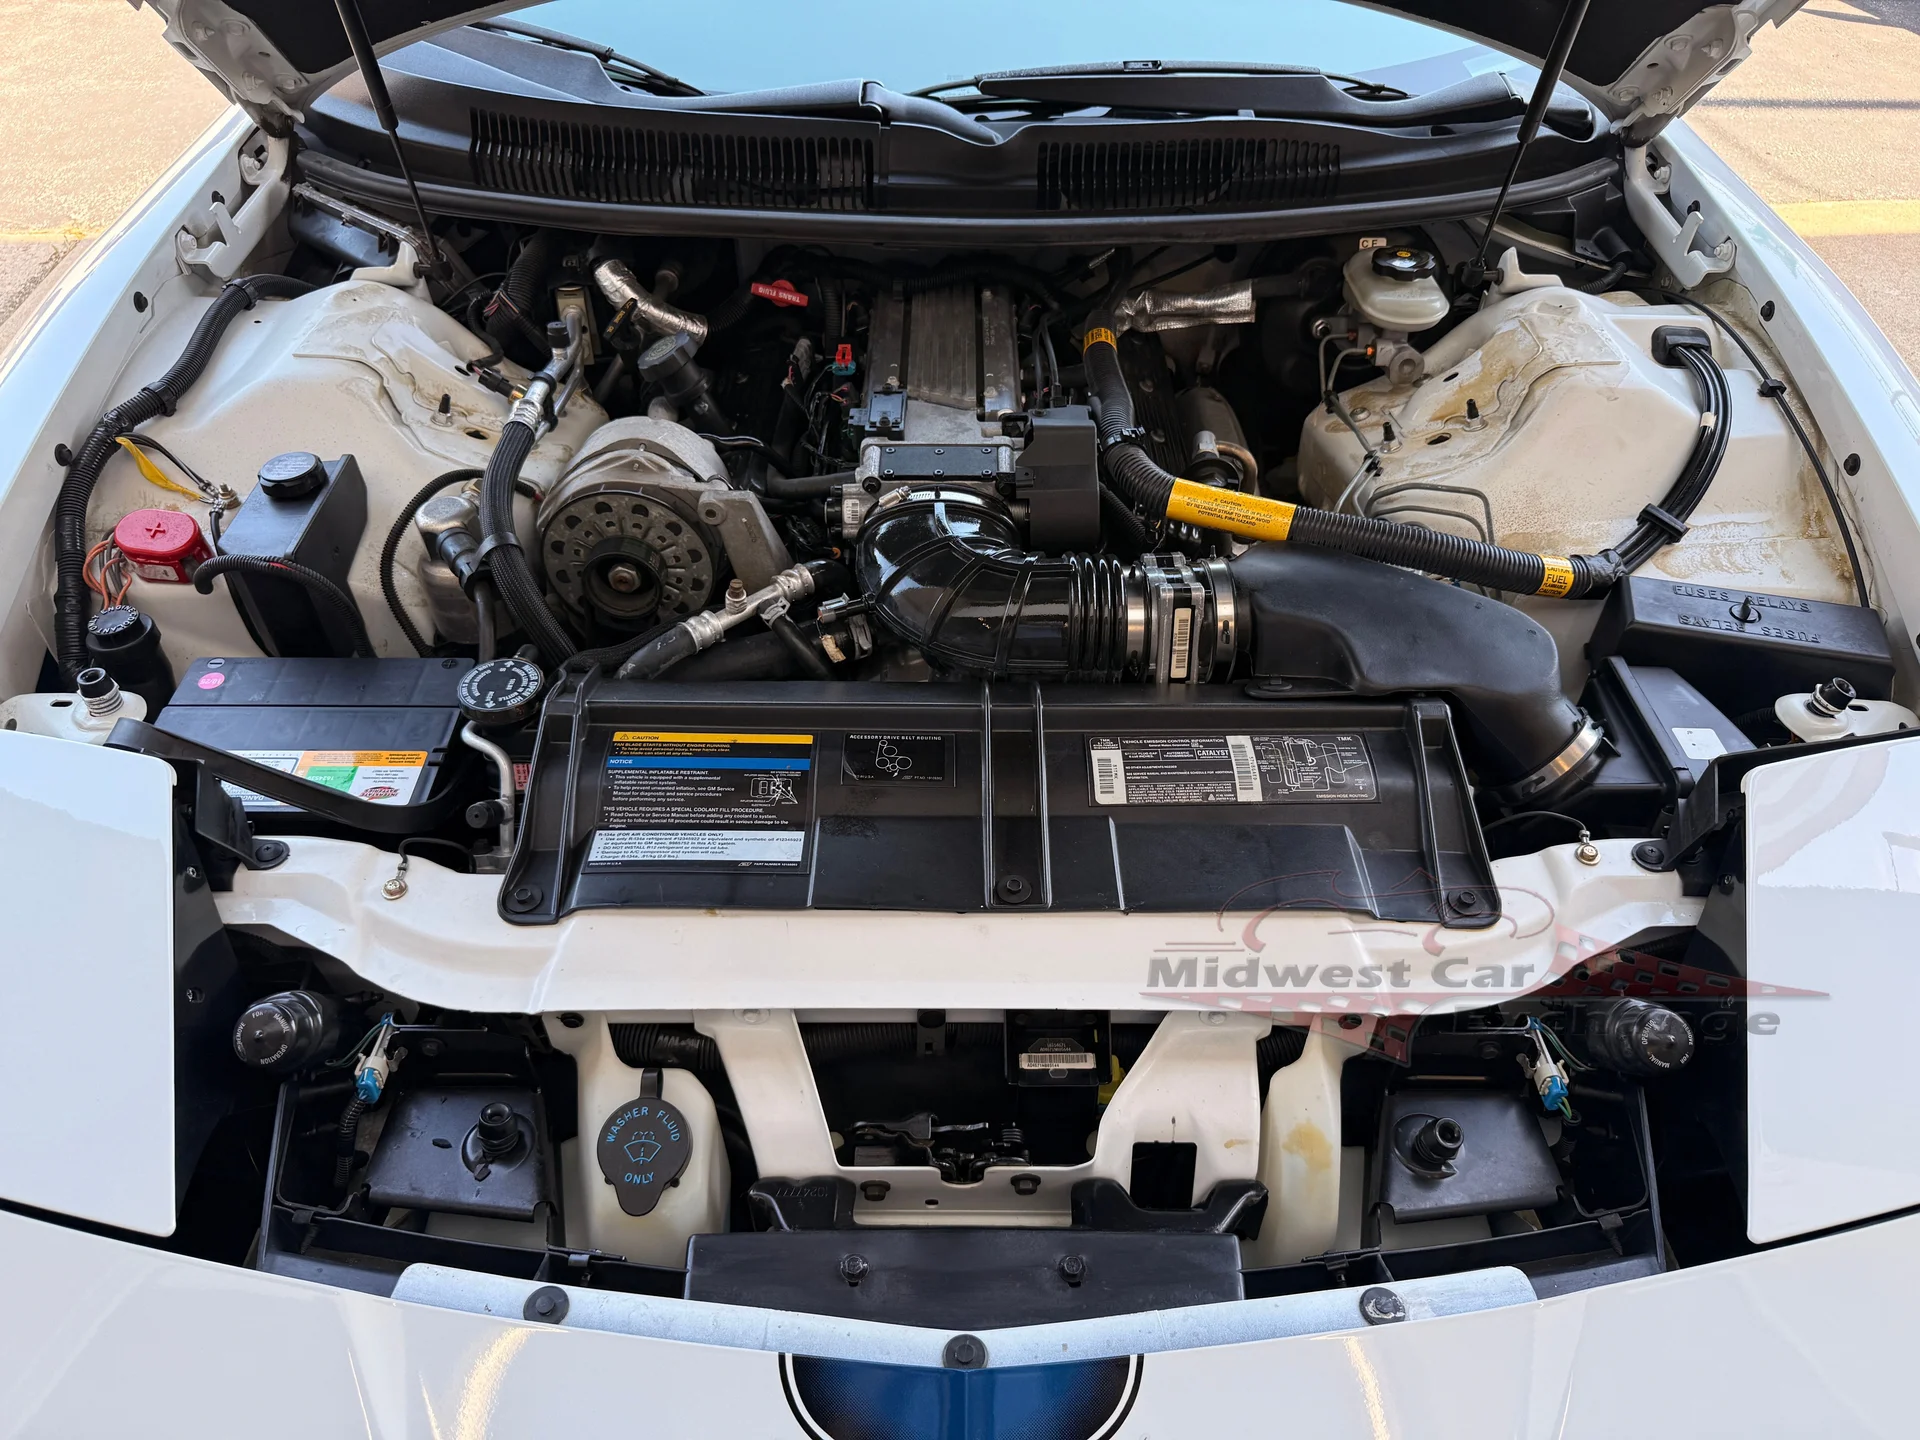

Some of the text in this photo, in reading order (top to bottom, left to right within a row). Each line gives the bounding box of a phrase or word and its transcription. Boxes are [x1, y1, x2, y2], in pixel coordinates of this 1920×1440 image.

[758, 287, 800, 302] TRANS FLUID
[1194, 504, 1217, 512] RETAINER
[1198, 510, 1223, 519] POTENTIAL
[1237, 518, 1256, 526] HAZARD
[1546, 574, 1568, 584] FUEL
[1674, 585, 1812, 613] FUSES RELAYS
[88, 605, 137, 633] ENGINE COOLANT ONLY
[1679, 614, 1820, 643] FUSES RELAYS
[507, 664, 538, 706] NEVER OPEN HOT
[498, 692, 519, 702] BOTTLE
[236, 1021, 246, 1044] REMOVE
[273, 1013, 290, 1033] MANUAL
[1682, 1023, 1693, 1046] REMOVE
[260, 1044, 288, 1064] OPERATION
[1649, 1054, 1670, 1068] MANUAL
[1680, 1052, 1689, 1064] FOR
[606, 1106, 680, 1184] WASHER FLUID ONLY
